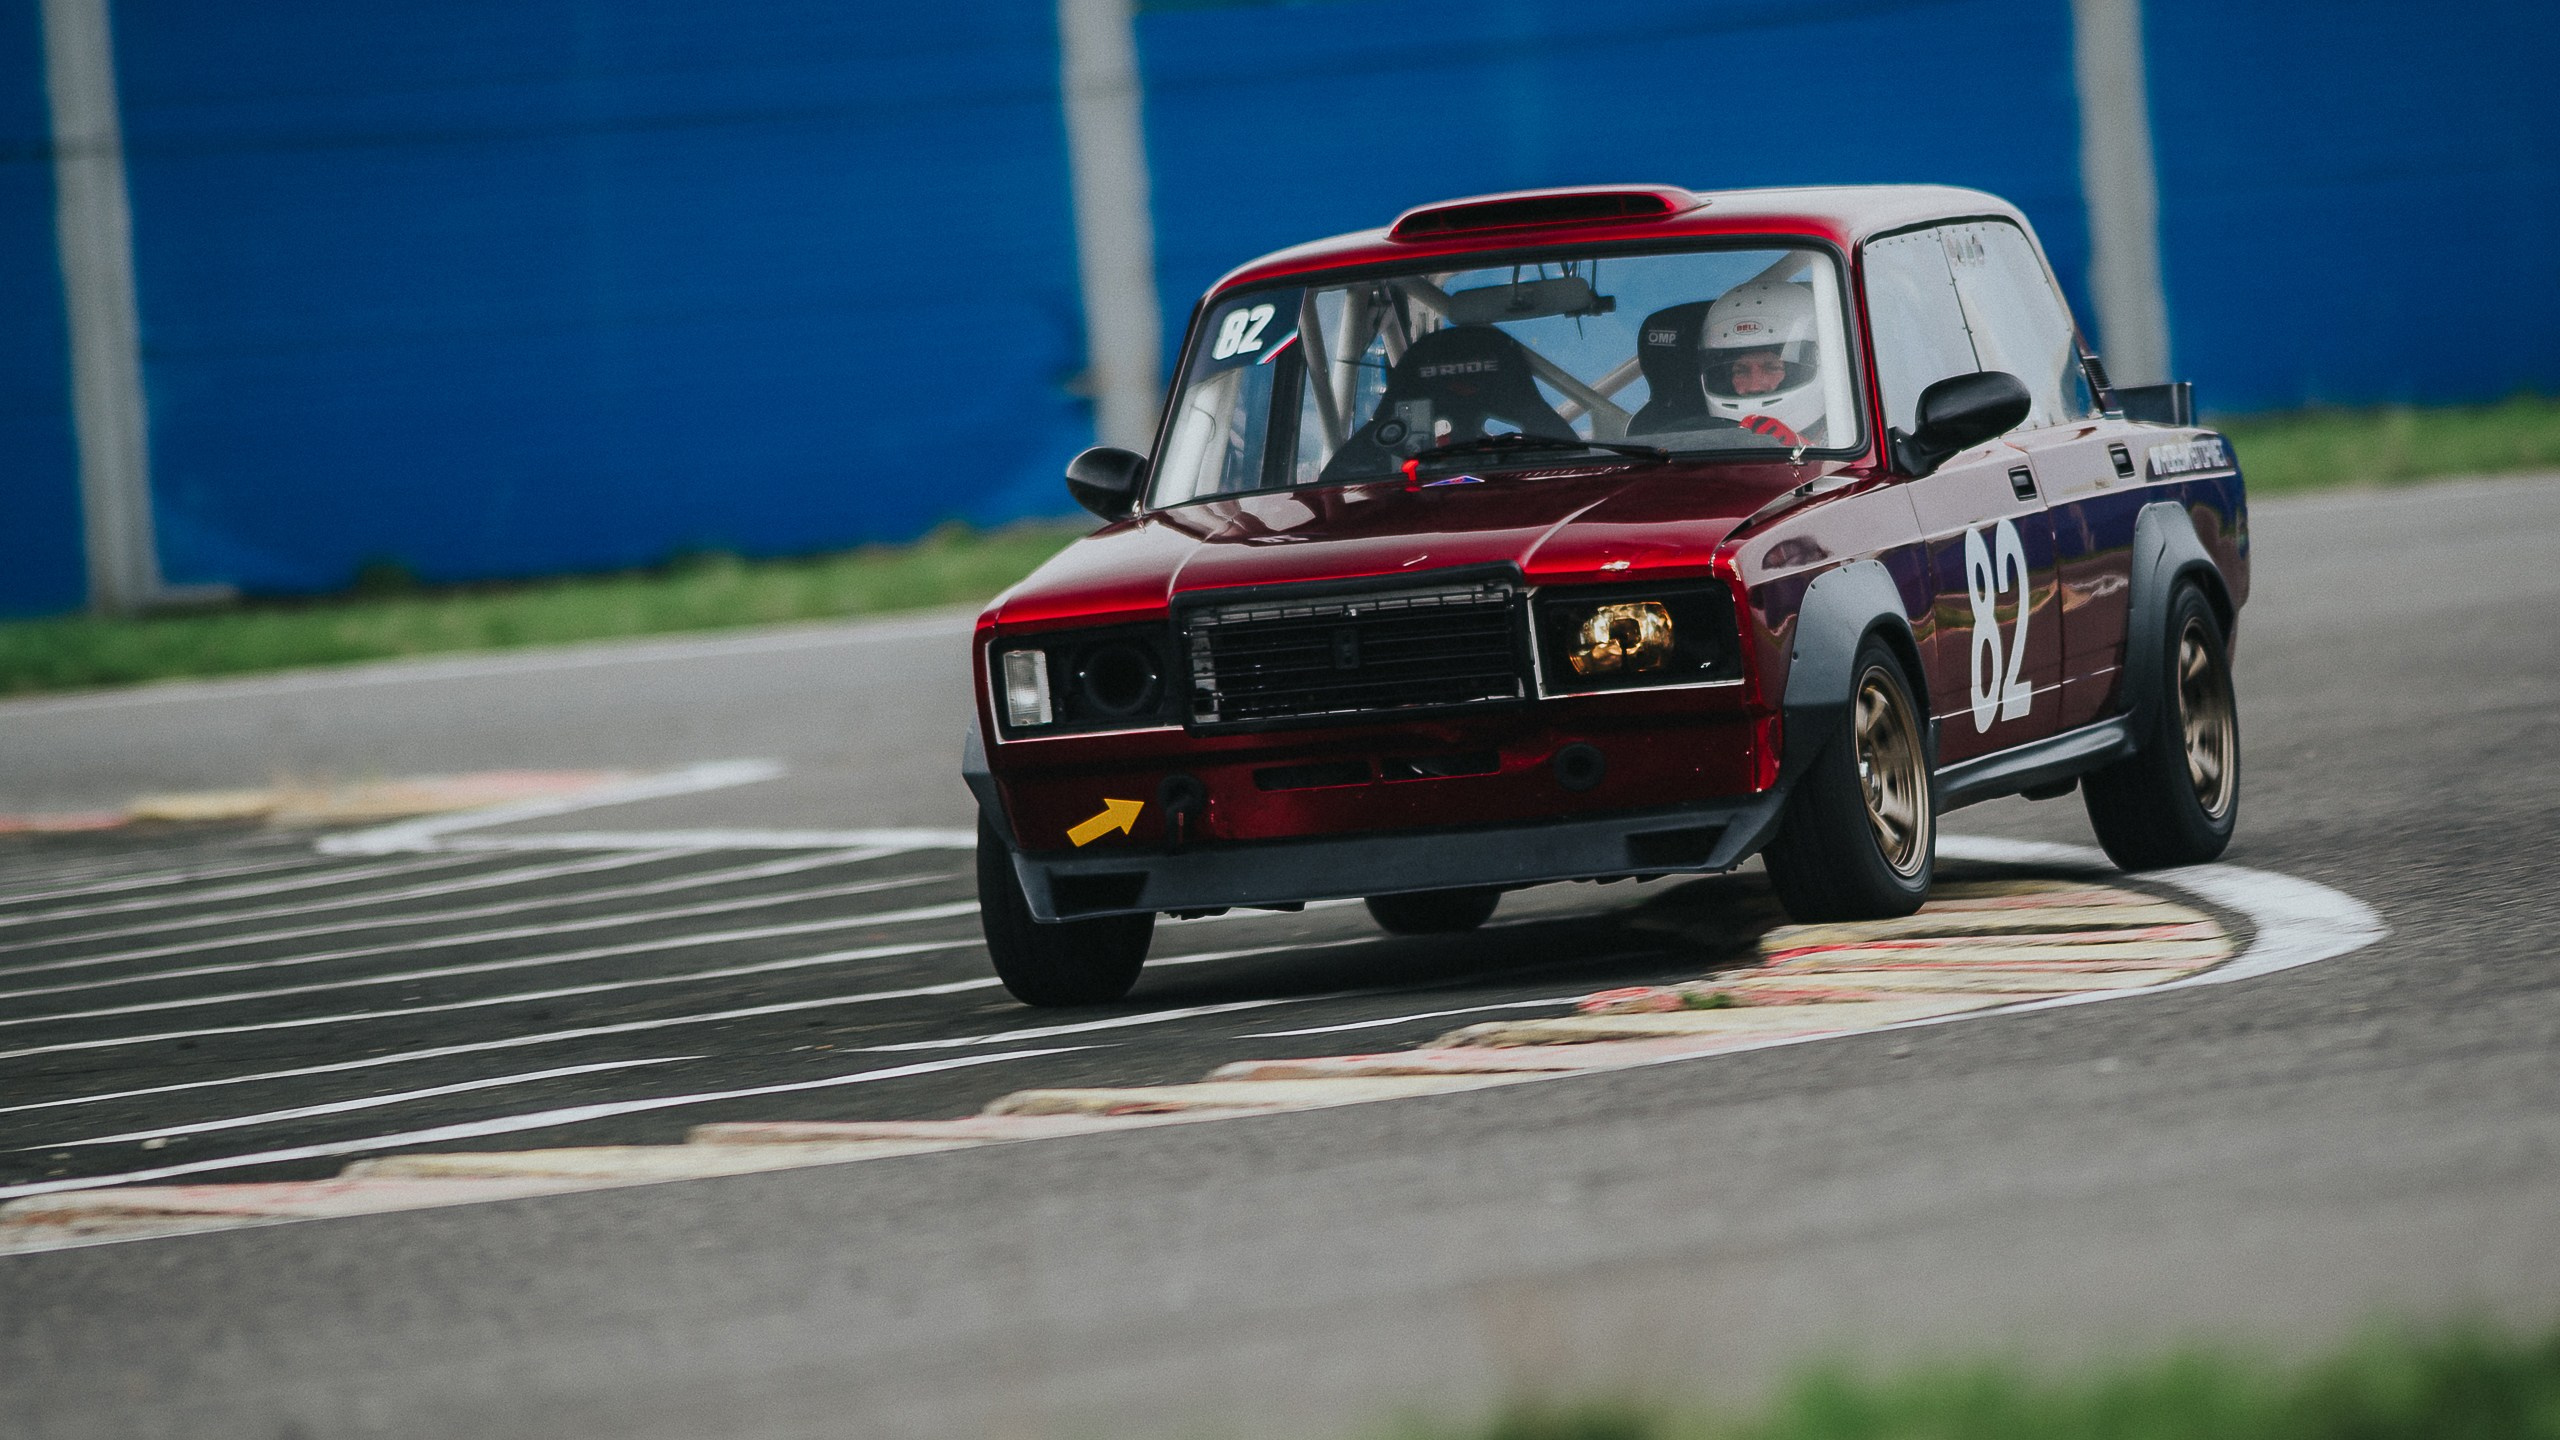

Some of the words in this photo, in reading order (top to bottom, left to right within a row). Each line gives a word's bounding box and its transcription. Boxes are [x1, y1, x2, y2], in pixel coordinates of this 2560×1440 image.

[1212, 303, 1276, 361] 82
[1736, 323, 1760, 332] BELL
[1648, 332, 1677, 344] OMP
[1419, 360, 1499, 378] BRIDE
[1964, 518, 2032, 734] 82
